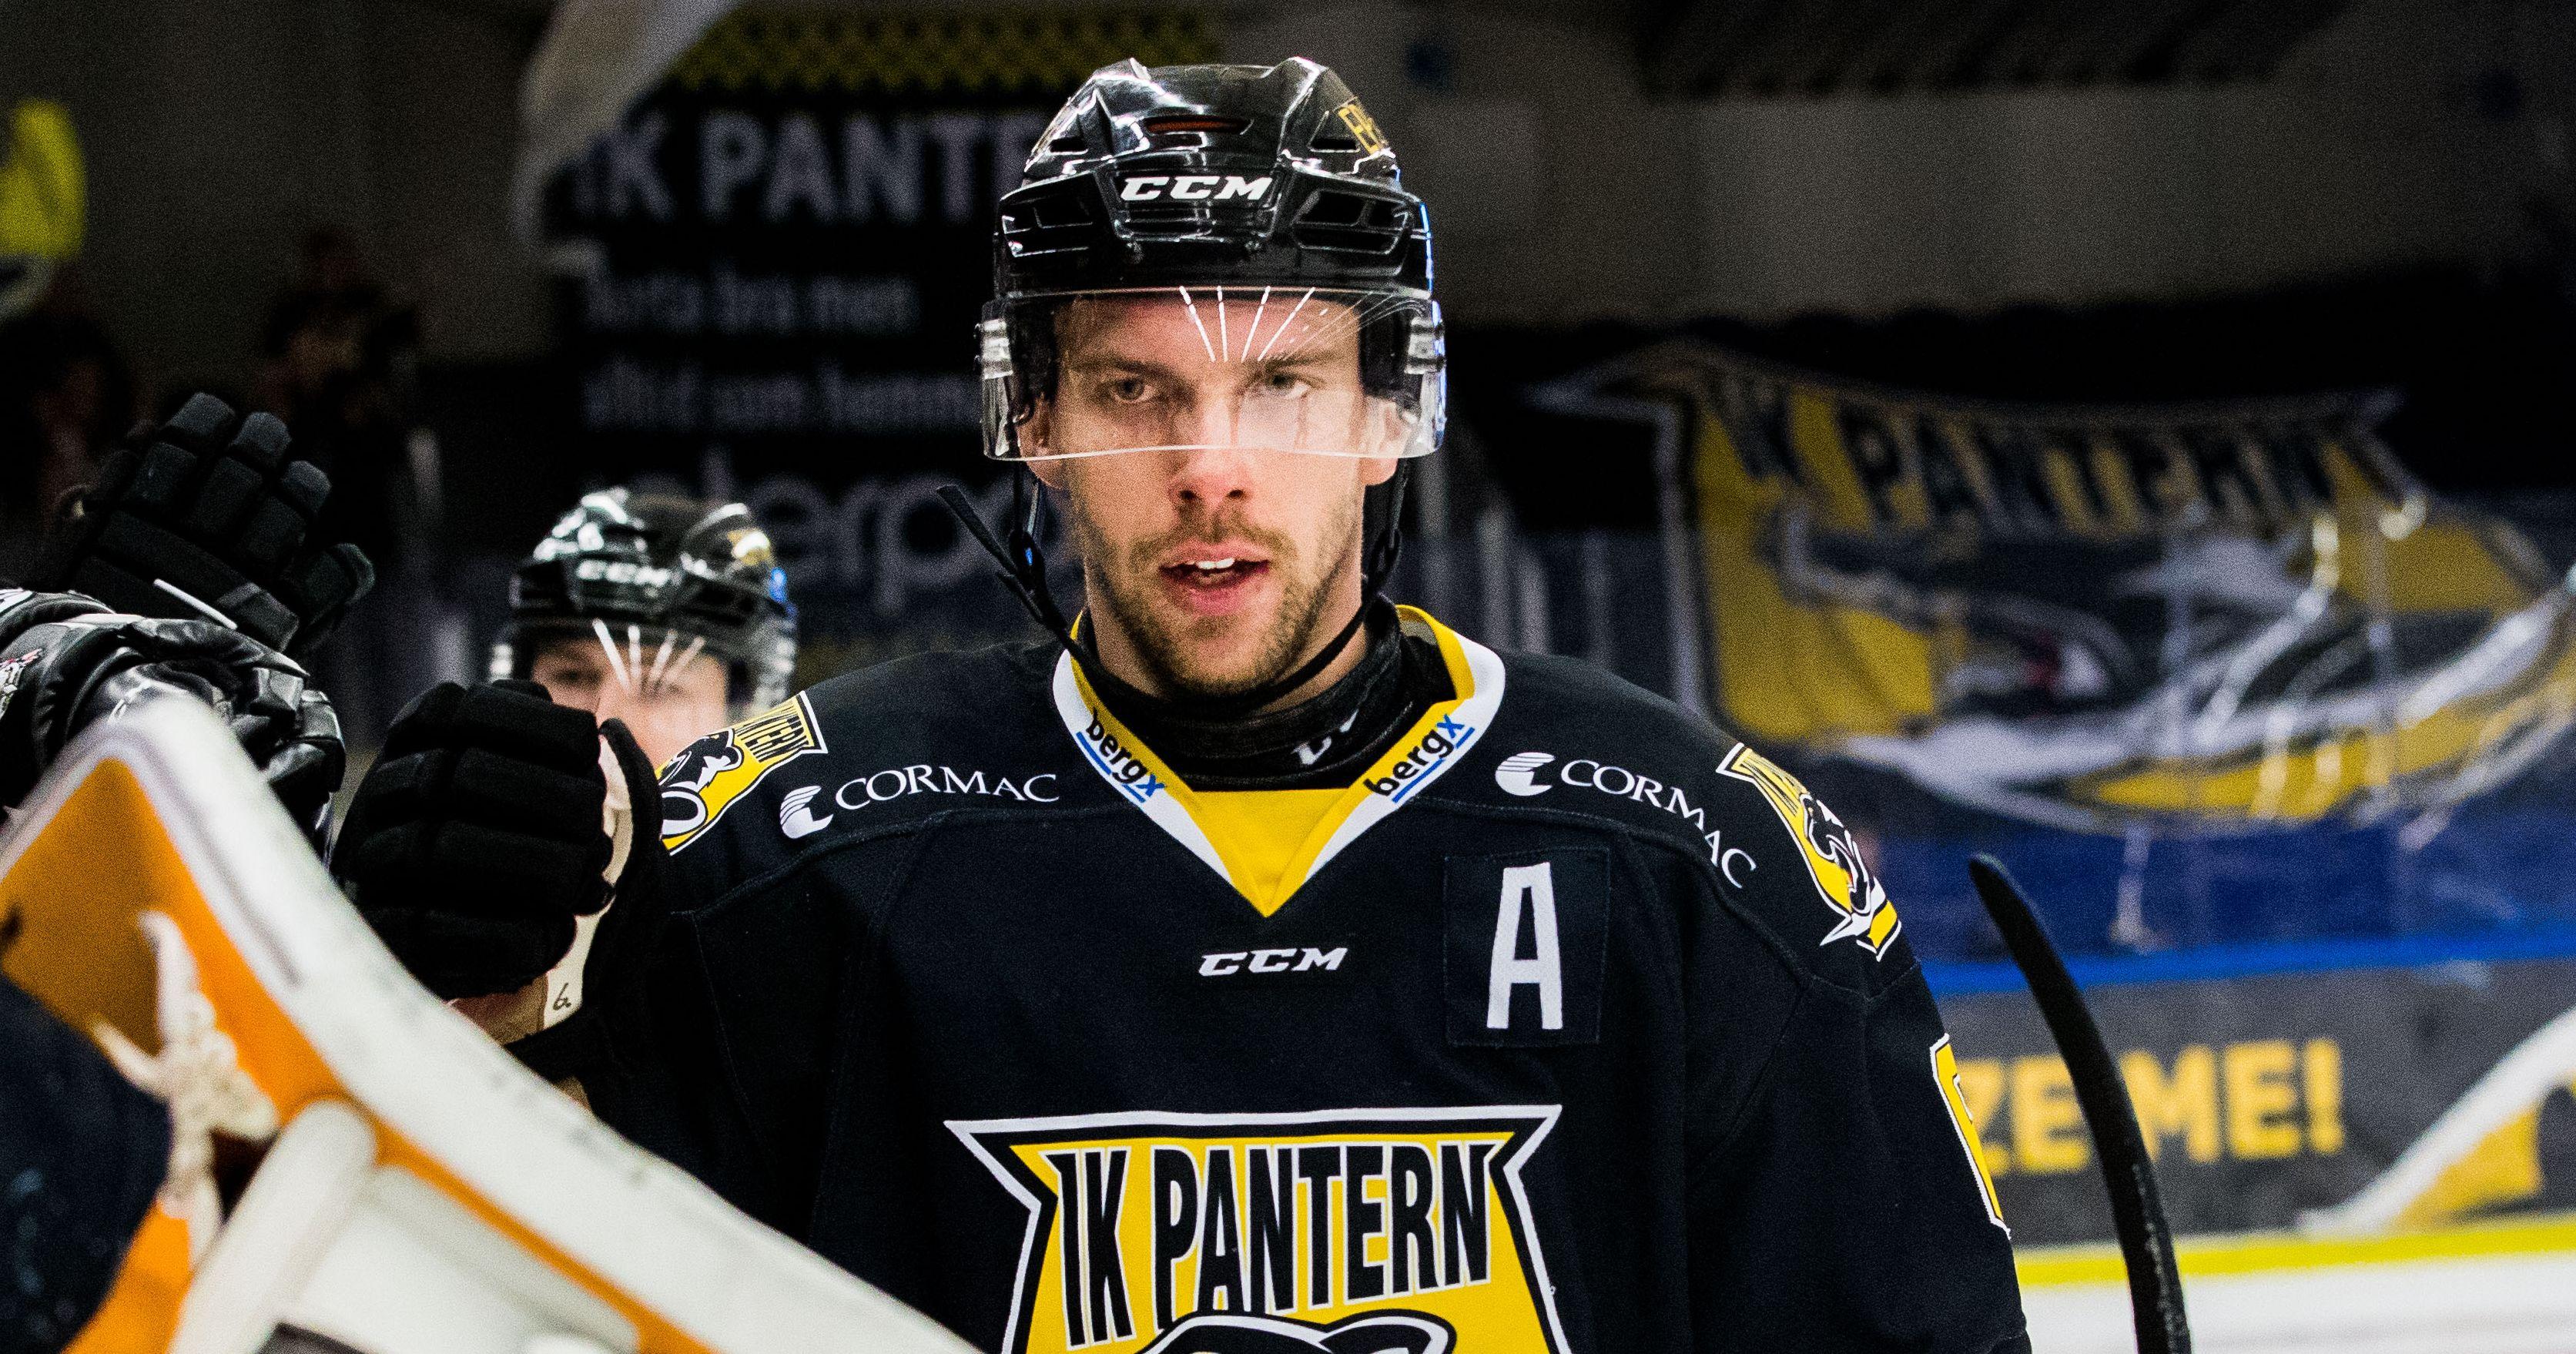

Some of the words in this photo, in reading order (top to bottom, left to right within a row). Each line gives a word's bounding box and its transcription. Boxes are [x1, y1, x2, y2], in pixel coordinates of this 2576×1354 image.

[1121, 176, 1272, 201] CCM
[835, 764, 1061, 810] CORMAC
[1085, 706, 1167, 798] bergx
[1364, 714, 1466, 797] bergx
[1560, 759, 1758, 890] CORMAC
[1198, 947, 1348, 977] CCM
[1486, 861, 1563, 1030] A
[2119, 1037, 2345, 1165] ME!
[1037, 1144, 1137, 1352] IK
[1148, 1139, 1507, 1337] PANTERN
